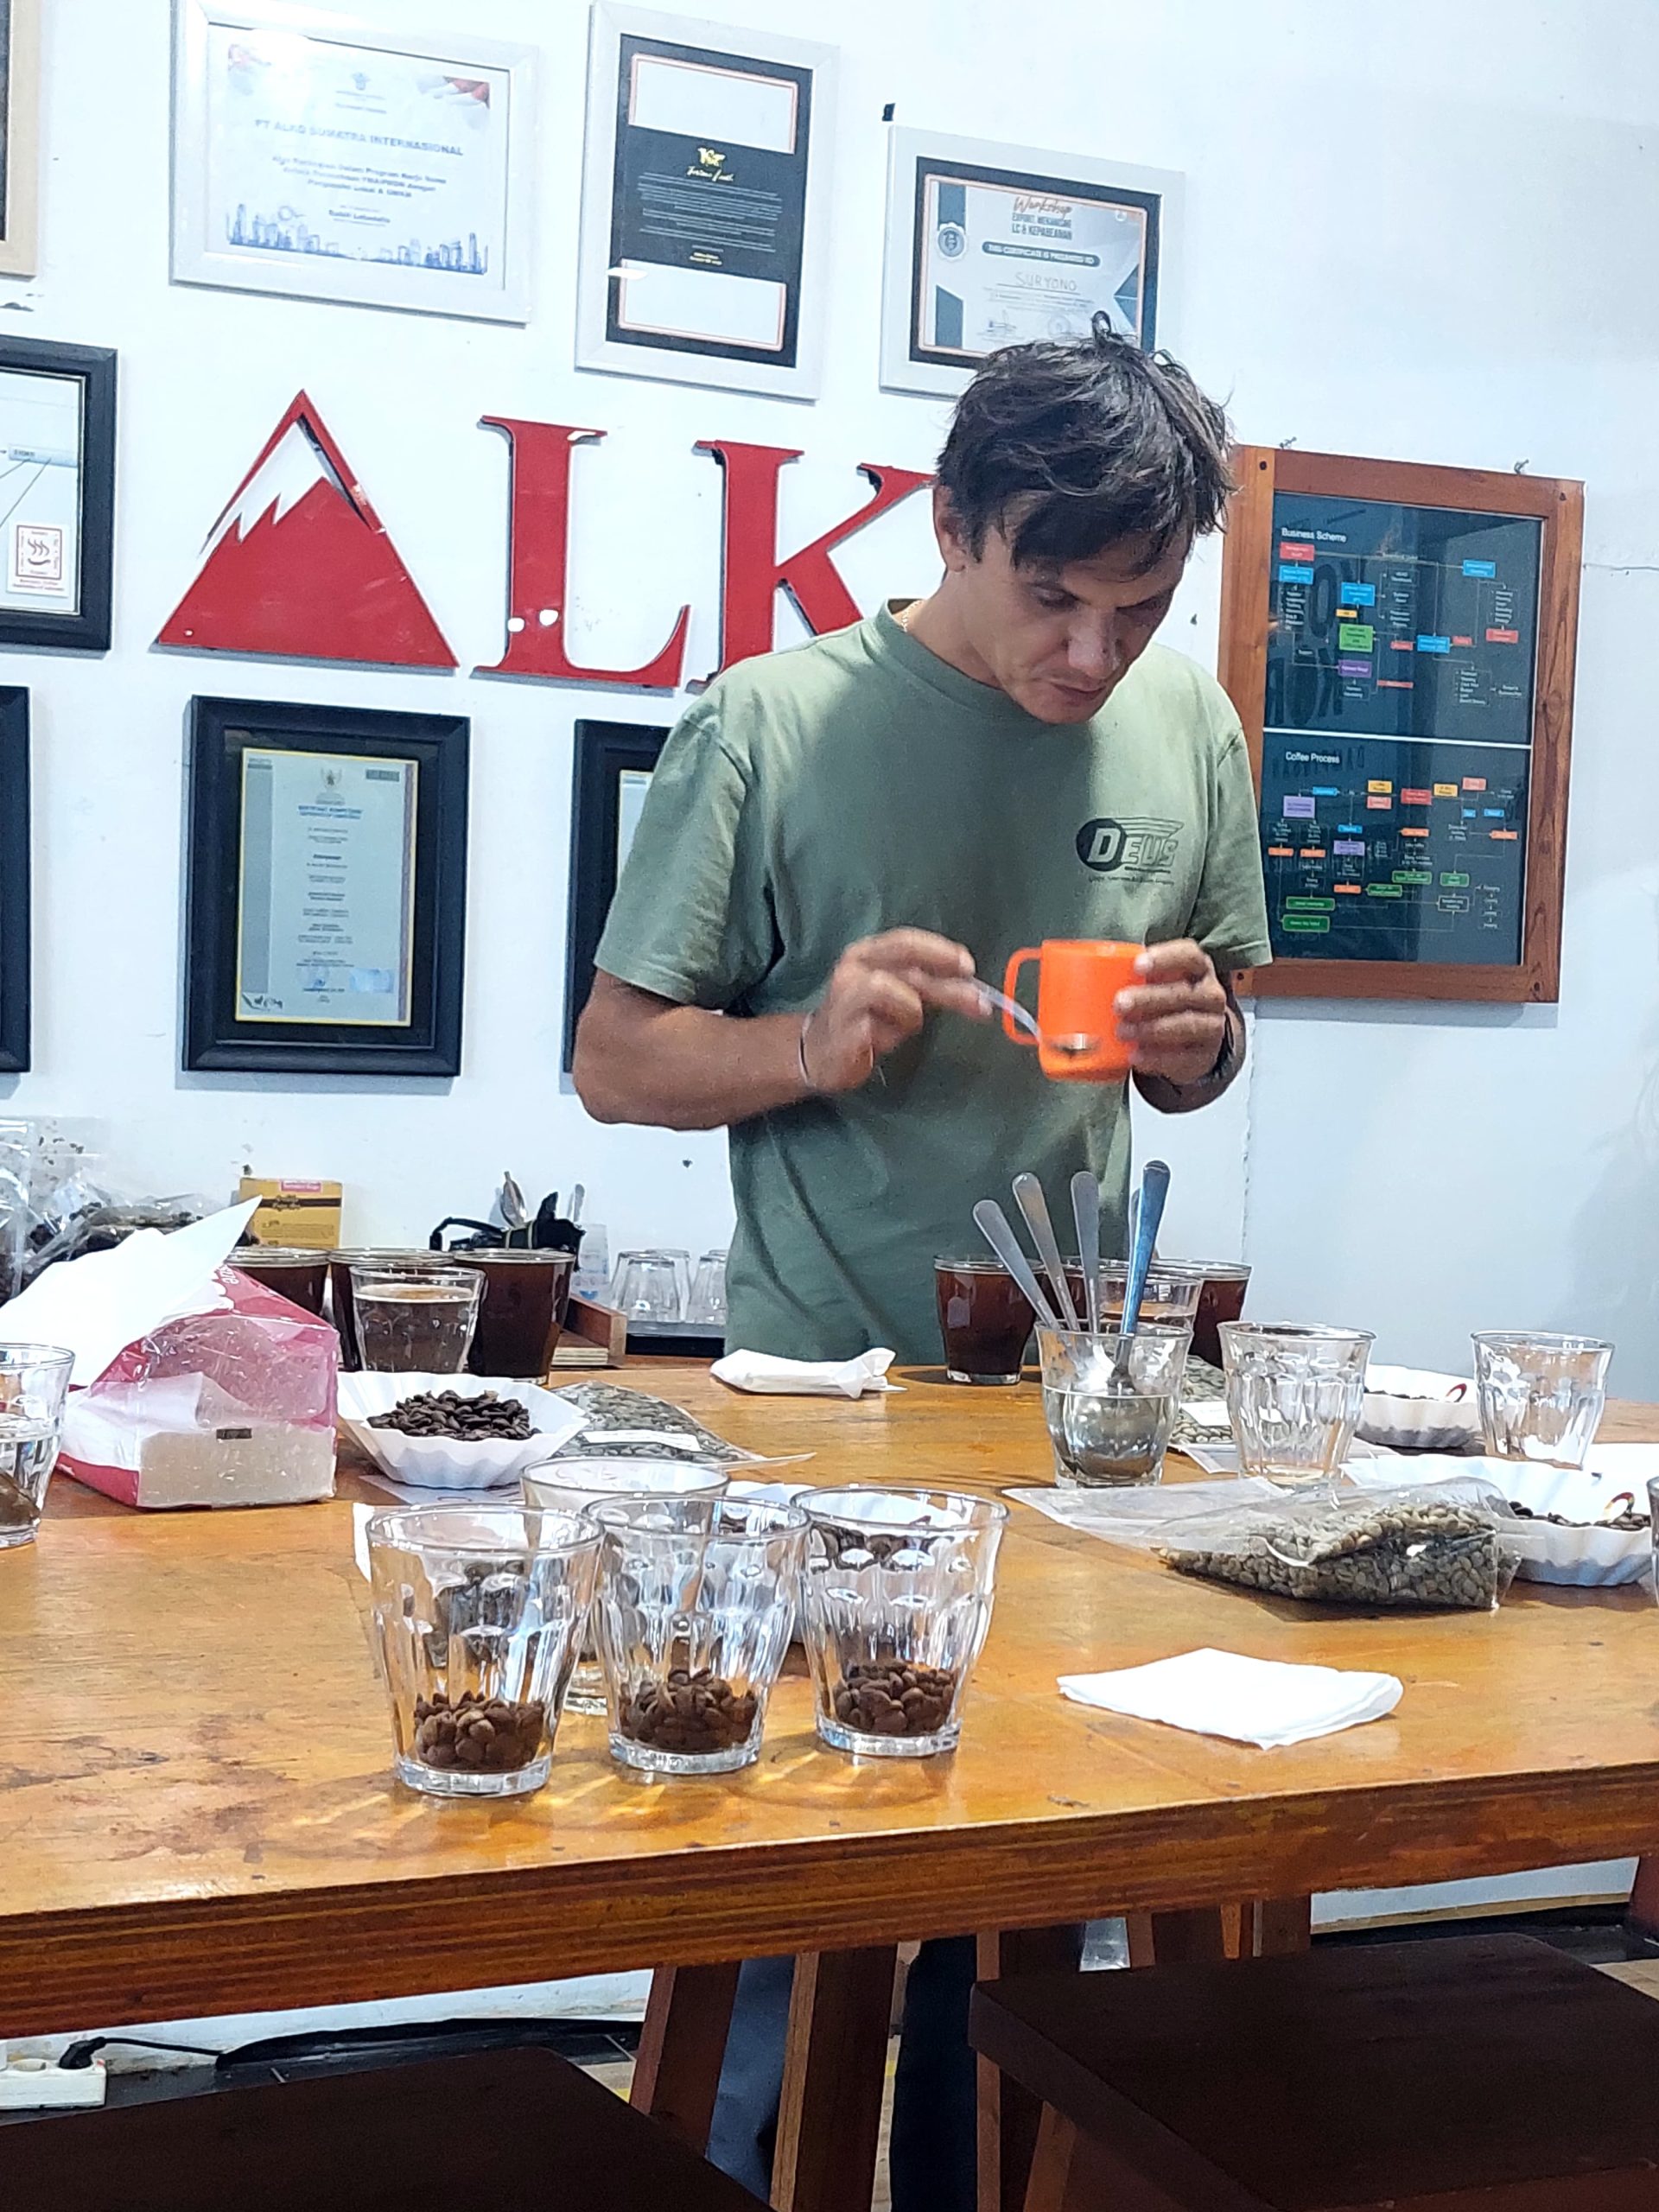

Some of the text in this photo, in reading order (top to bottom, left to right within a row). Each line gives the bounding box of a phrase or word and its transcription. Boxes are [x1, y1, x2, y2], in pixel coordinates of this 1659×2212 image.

[1015, 272, 1077, 291] SURYONO
[1281, 527, 1347, 543] Business Scheme
[1286, 751, 1340, 765] Coffee Process
